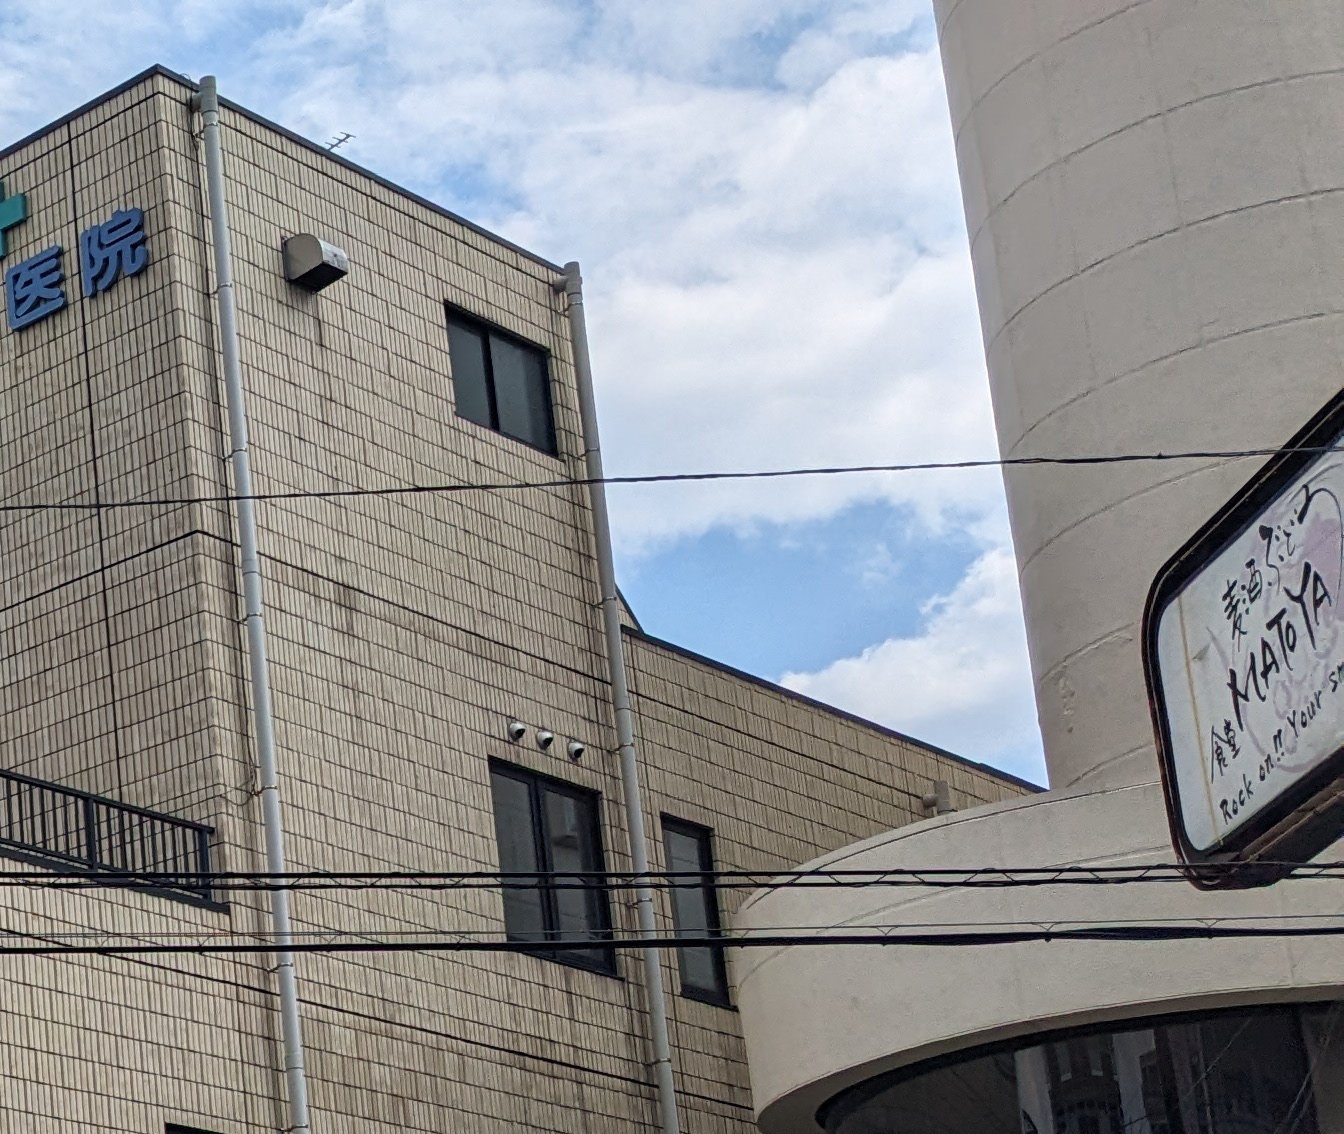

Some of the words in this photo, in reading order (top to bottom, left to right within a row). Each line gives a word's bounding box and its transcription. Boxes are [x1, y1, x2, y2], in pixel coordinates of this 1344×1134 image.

[1227, 561, 1332, 732] MATOYA
[1219, 773, 1254, 825] Rock
[1287, 690, 1322, 738] Your
